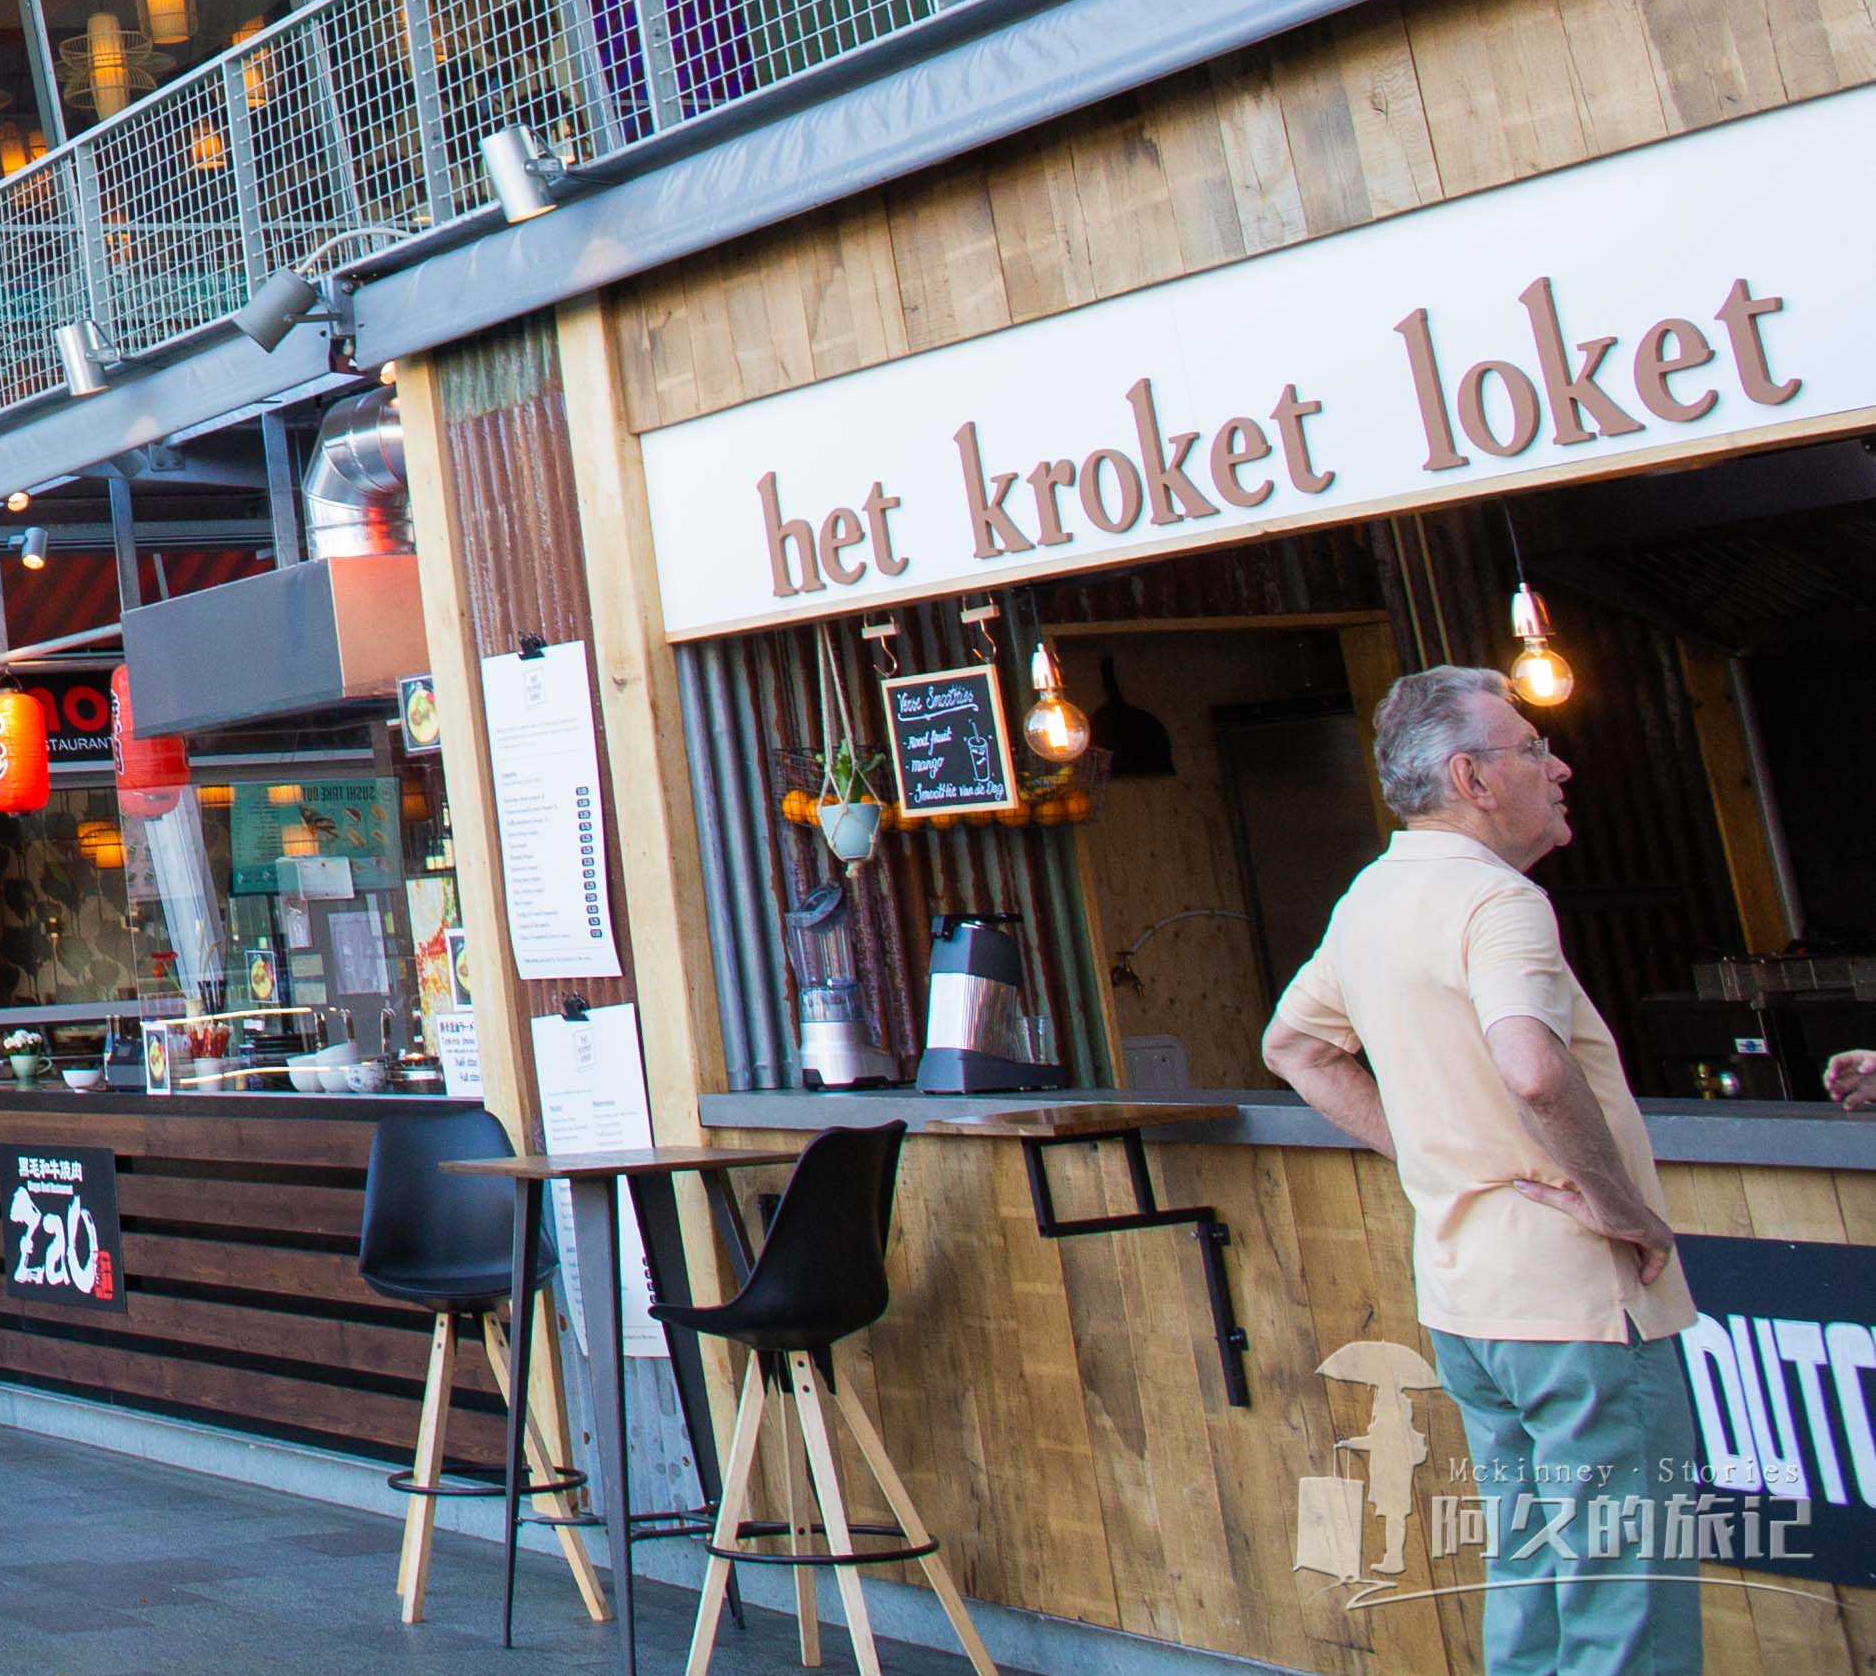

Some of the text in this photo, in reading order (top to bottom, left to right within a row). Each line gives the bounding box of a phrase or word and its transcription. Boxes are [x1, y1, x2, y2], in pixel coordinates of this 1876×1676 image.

[755, 274, 1804, 601] het kroket loket
[925, 684, 975, 710] Smoothies
[958, 784, 975, 797] van
